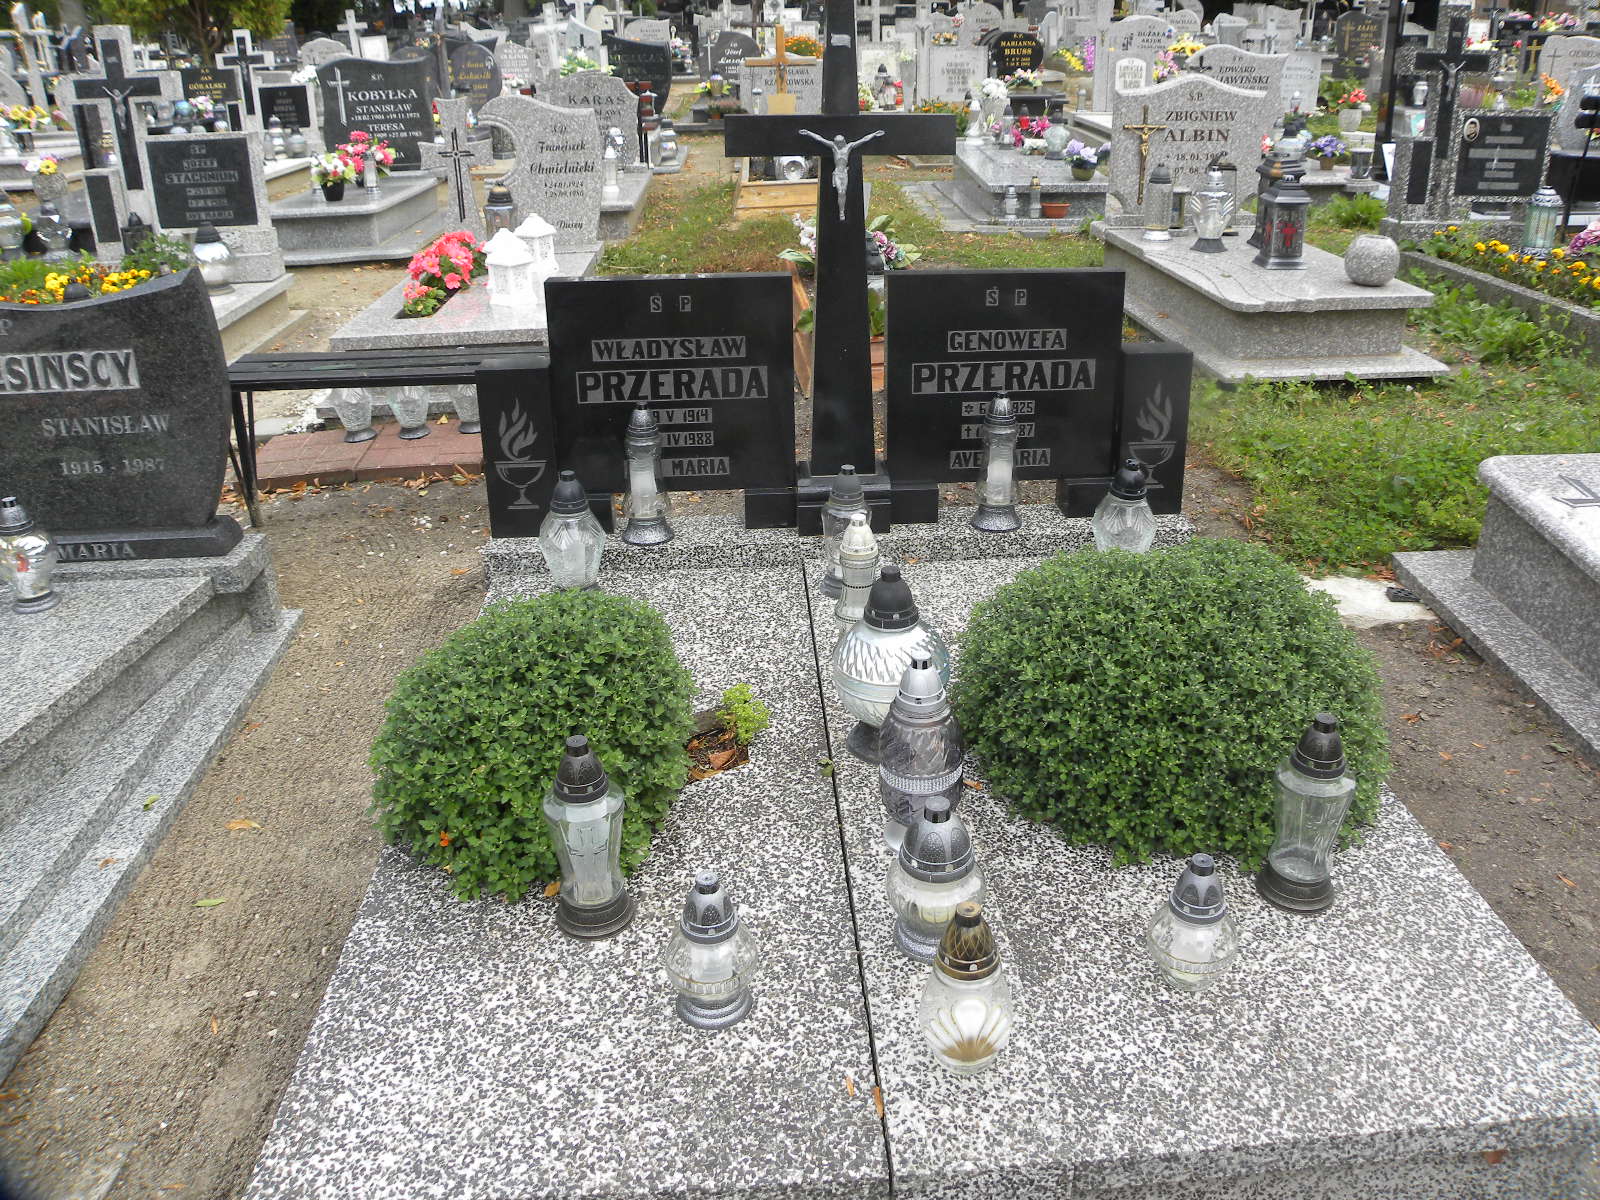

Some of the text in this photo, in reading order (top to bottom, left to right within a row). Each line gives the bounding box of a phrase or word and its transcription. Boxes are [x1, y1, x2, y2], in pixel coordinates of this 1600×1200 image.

[347, 88, 418, 101] KOBYŁKA
[356, 104, 412, 114] STANISŁAW
[1166, 110, 1237, 121] ZBIGNIEW
[368, 122, 405, 132] TERESA
[1165, 129, 1230, 141] ALBIN
[530, 161, 594, 175] Chmielnicki
[680, 296, 691, 312] P
[1016, 290, 1027, 305] P
[593, 337, 745, 360] WŁADYSŁAW
[949, 330, 1066, 351] GENOWEFA
[0, 351, 133, 391] SINSCY
[913, 360, 1094, 393] PRZERADA
[577, 367, 767, 402] PRZERADA
[666, 409, 675, 422] V
[683, 408, 710, 422] 1914
[41, 414, 170, 437] STANISŁAW
[667, 430, 713, 446] IV 1988
[59, 460, 104, 476] 1915
[122, 457, 165, 474] 1987
[671, 459, 728, 475] MARIA
[56, 542, 137, 560] MARIA
